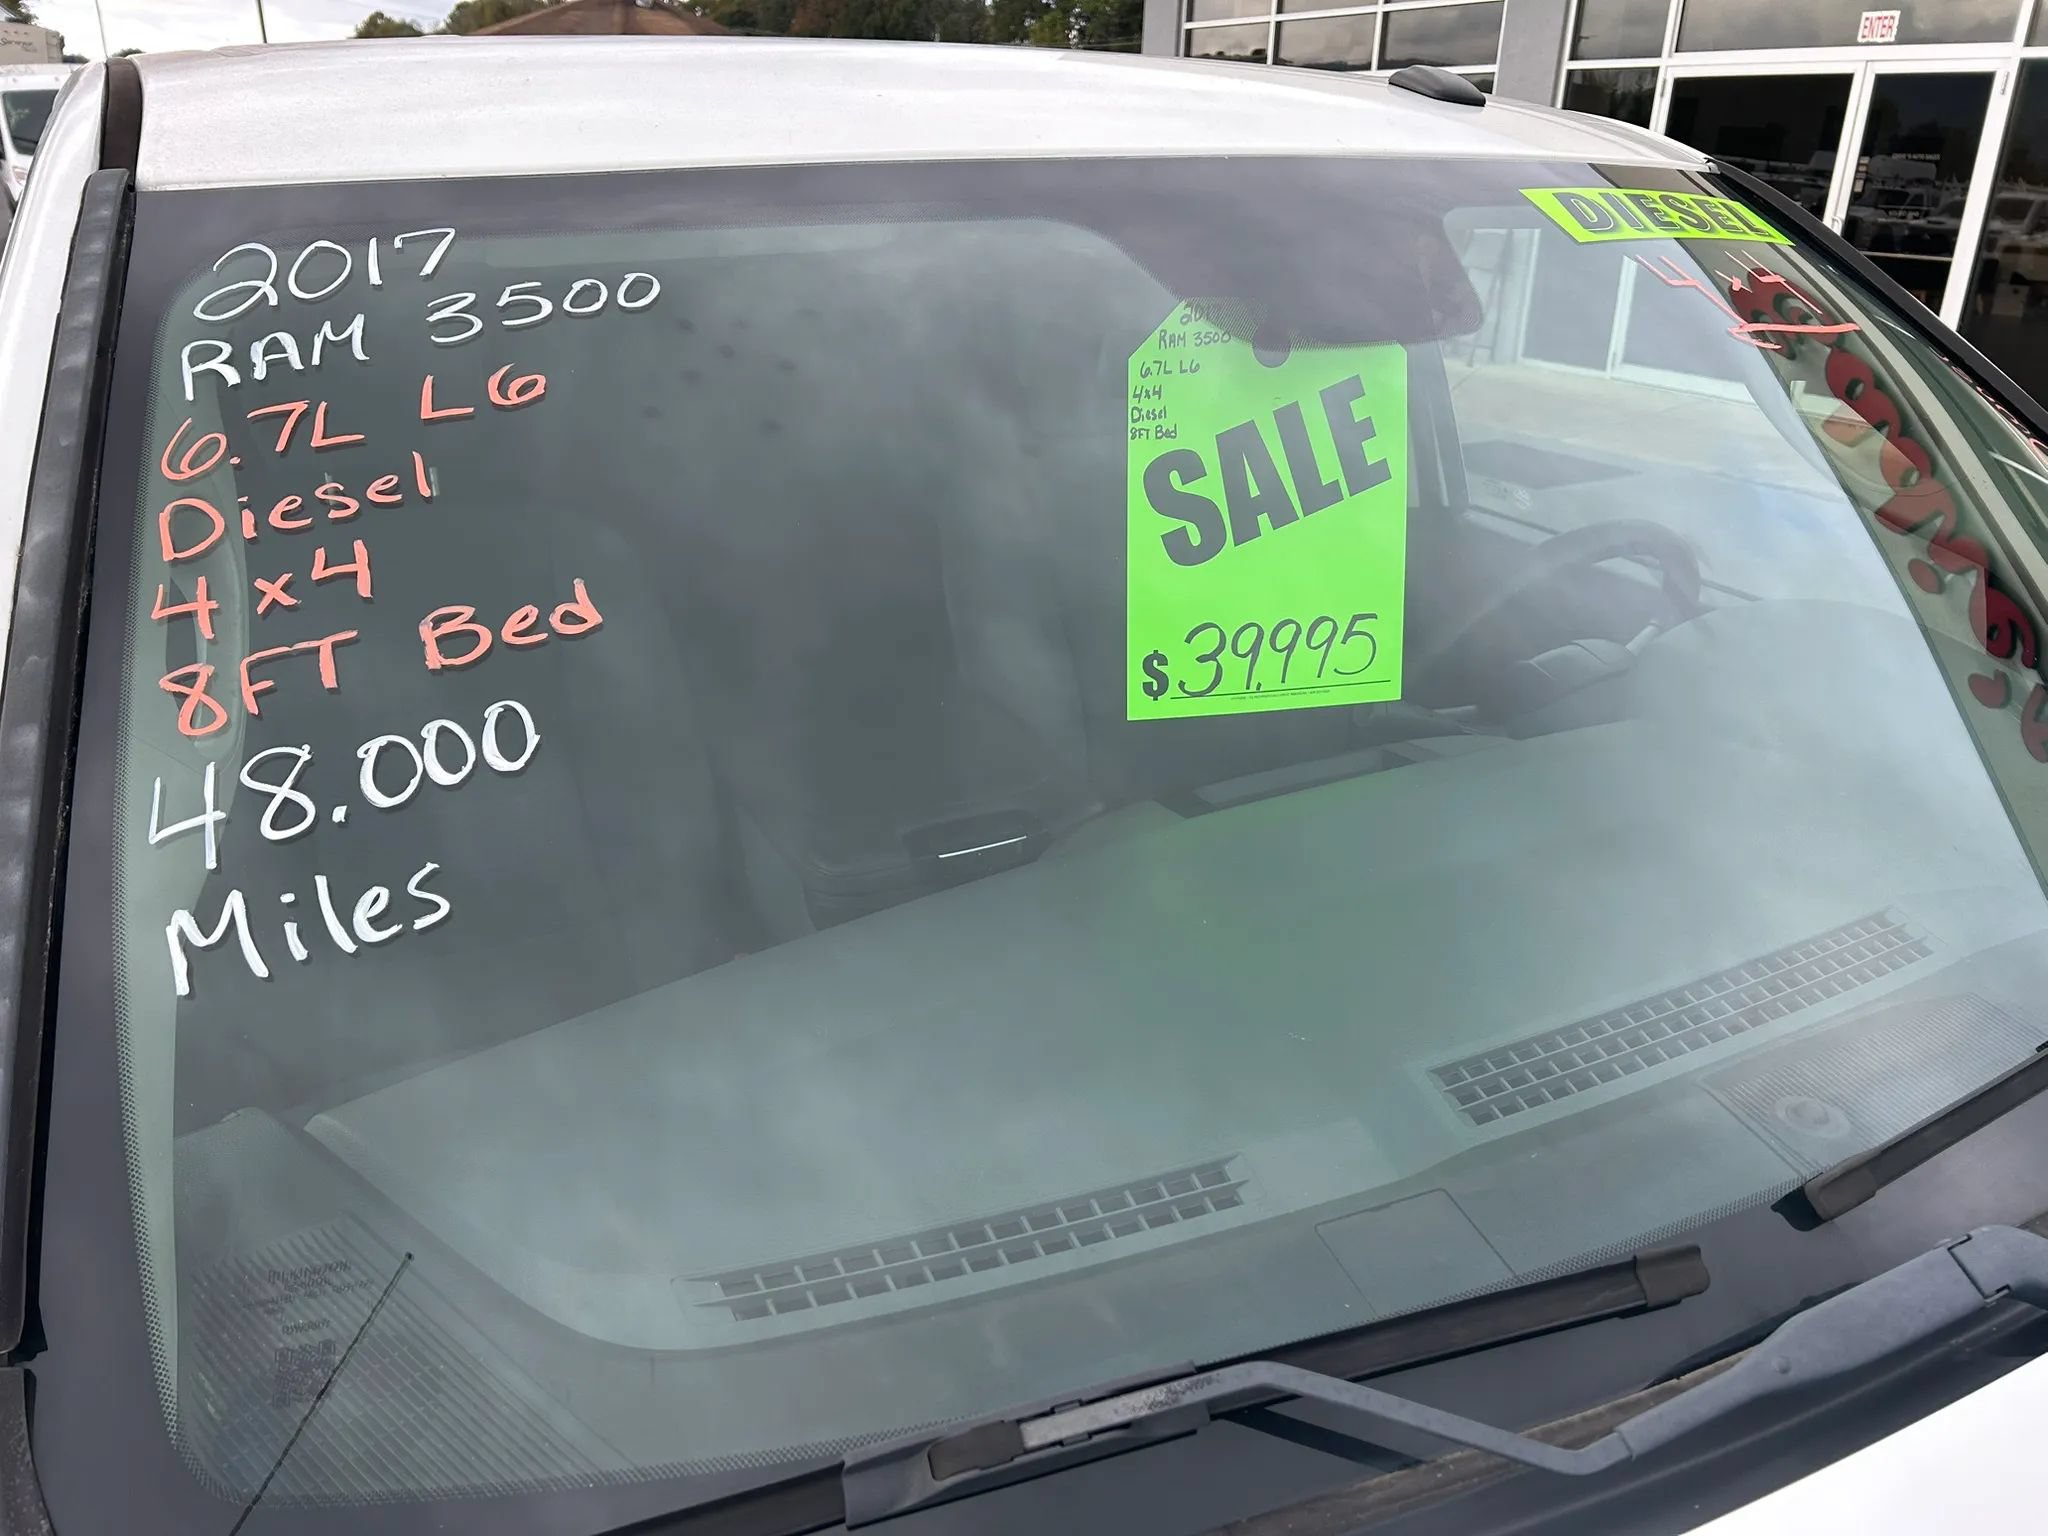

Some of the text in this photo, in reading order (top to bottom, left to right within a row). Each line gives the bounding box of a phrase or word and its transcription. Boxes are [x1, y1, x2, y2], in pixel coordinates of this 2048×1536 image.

[1861, 15, 1896, 39] ENTER
[1551, 192, 1772, 238] DIESEL
[193, 228, 456, 321] 2017
[180, 272, 661, 401] RAM 3500
[1158, 328, 1232, 350] RAM 3500
[1130, 405, 1167, 424] Diesel
[1132, 383, 1163, 404] 4x4
[1154, 423, 1178, 440] Bed
[160, 400, 366, 481] 6.7L
[1142, 373, 1393, 568] SALE
[158, 451, 433, 562] Diesel
[418, 578, 603, 670] Bed
[166, 862, 451, 996] Miles
